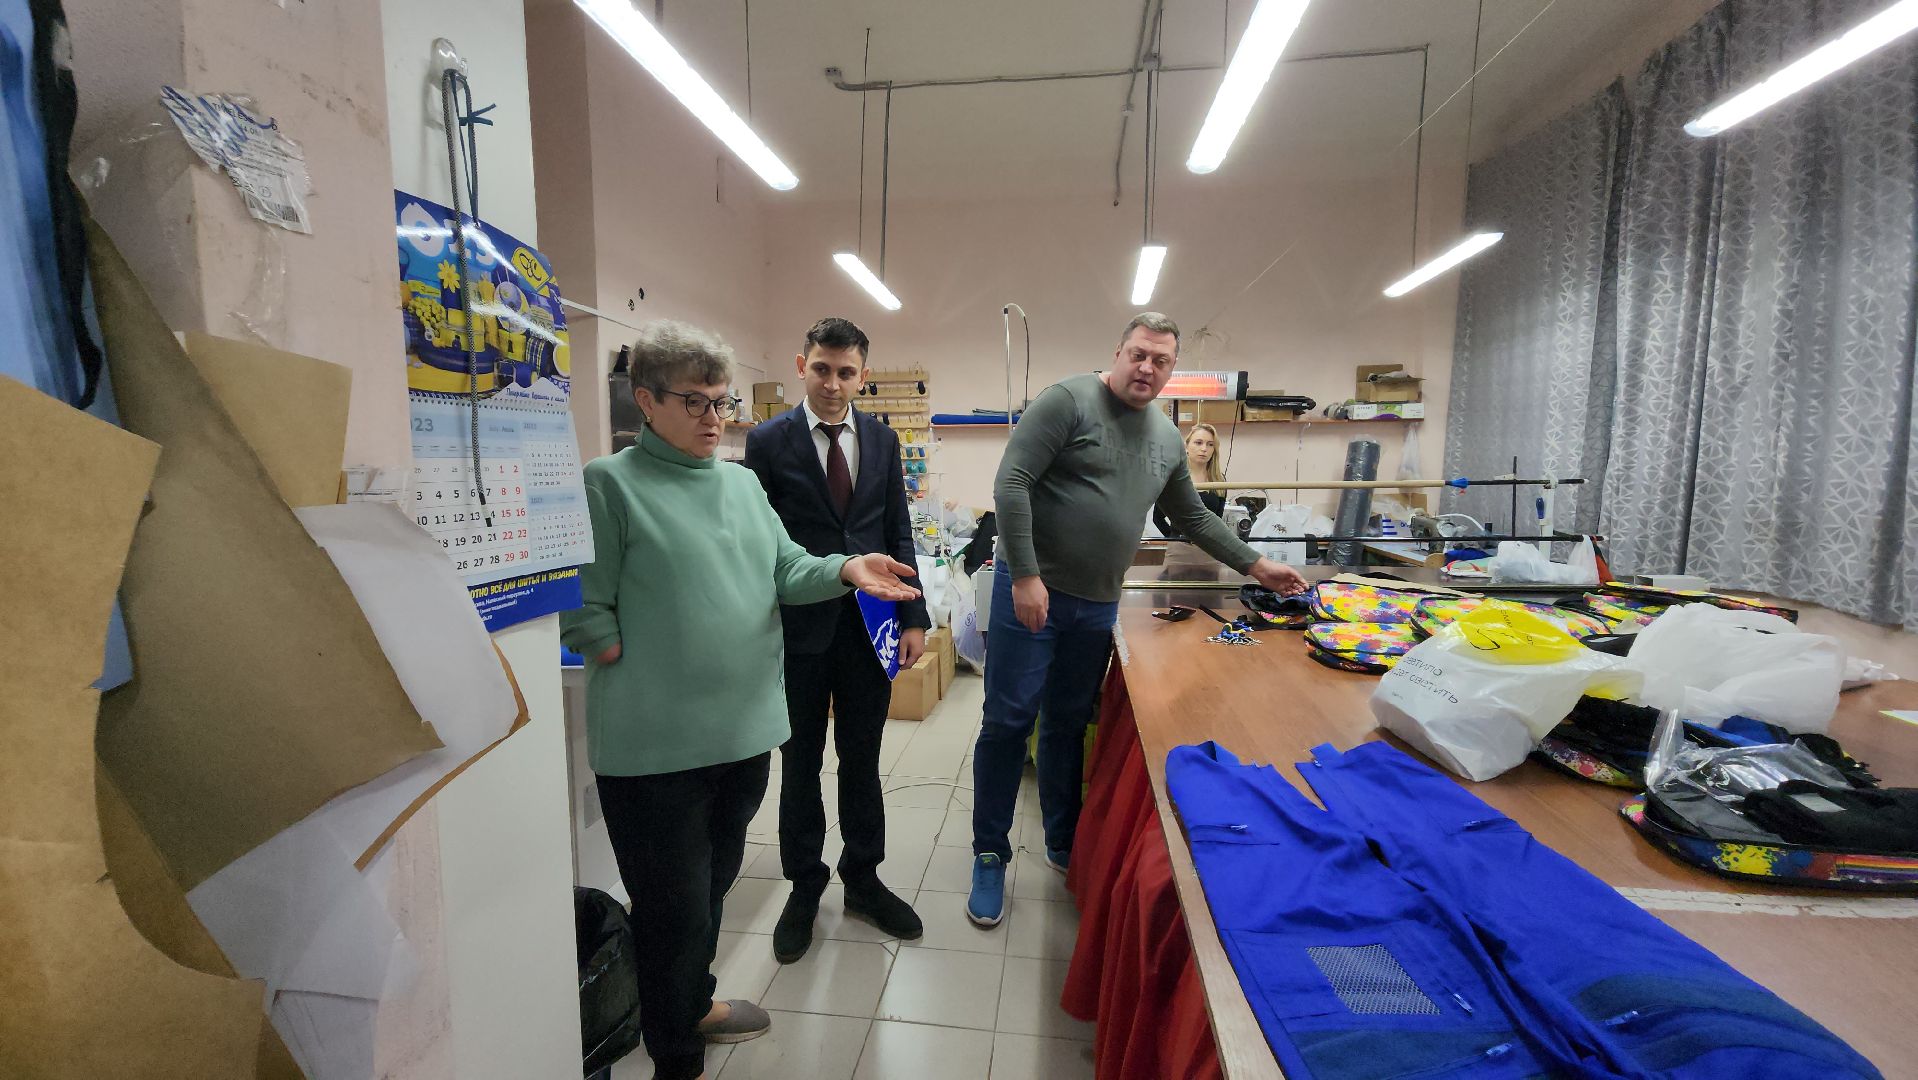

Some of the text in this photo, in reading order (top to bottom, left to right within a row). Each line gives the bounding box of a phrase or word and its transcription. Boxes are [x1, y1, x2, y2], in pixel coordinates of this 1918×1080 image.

[499, 465, 504, 473] 1
[513, 465, 519, 473] 2
[1103, 446, 1168, 481] URTHER
[416, 486, 521, 501] 3 4 5 6 7 8 9
[416, 516, 428, 526] 10
[434, 515, 447, 525] 11
[453, 513, 465, 523] 12
[470, 512, 481, 521] 13
[501, 509, 511, 518] 15
[516, 508, 526, 517] 16
[455, 537, 466, 547] 19
[471, 534, 482, 544] 20
[488, 532, 497, 542] 21
[502, 531, 513, 541] 22
[517, 529, 527, 538] 23
[456, 560, 468, 570] 26
[474, 558, 484, 568] 27
[490, 555, 500, 564] 28
[504, 552, 515, 562] 29
[519, 550, 529, 560] 30
